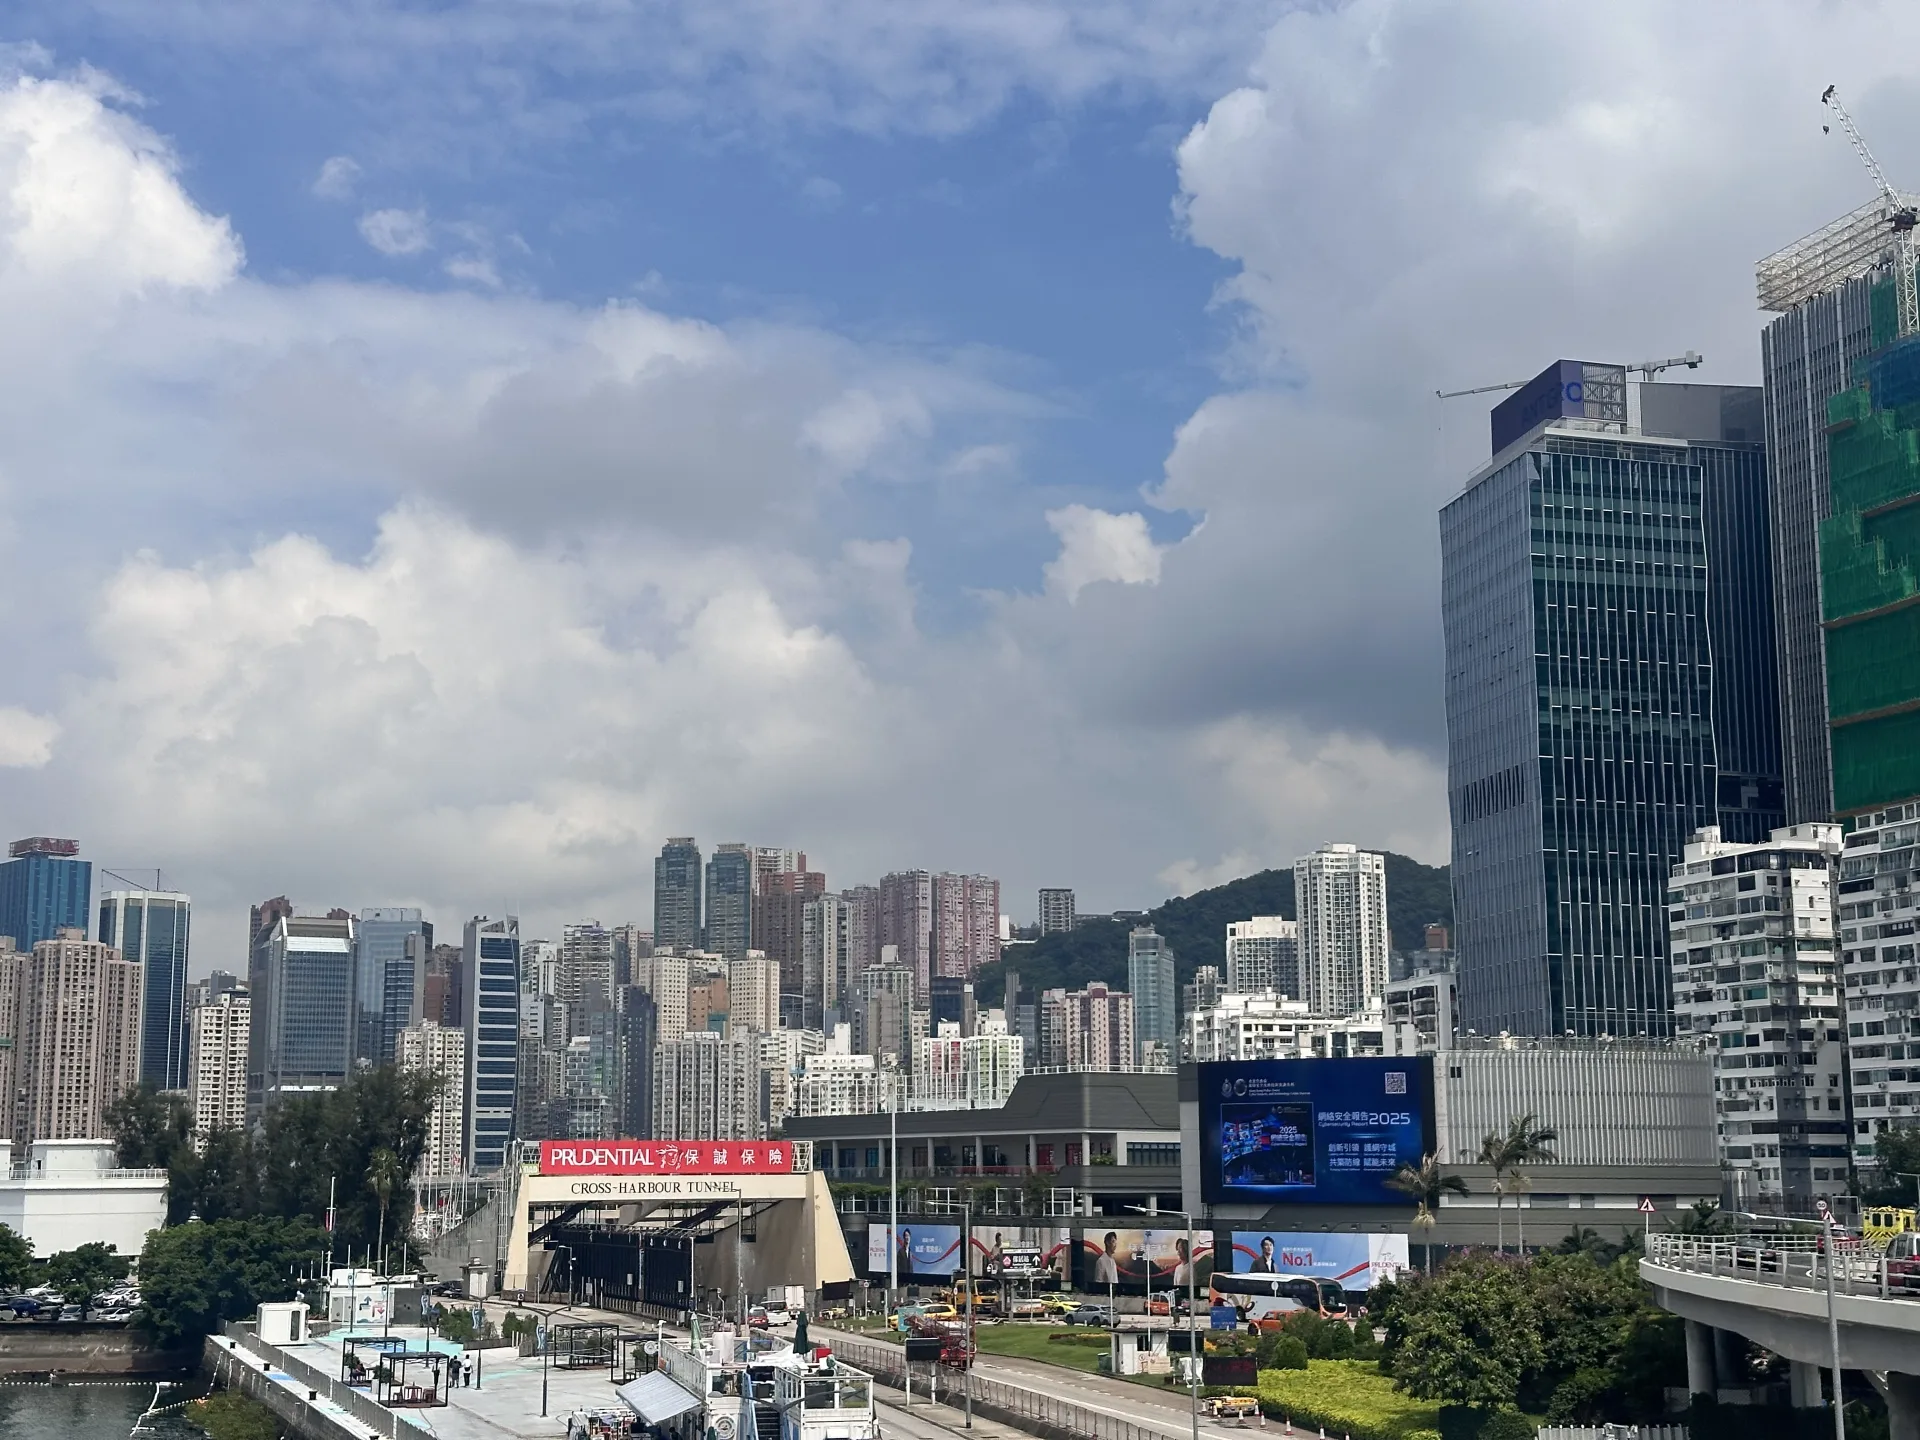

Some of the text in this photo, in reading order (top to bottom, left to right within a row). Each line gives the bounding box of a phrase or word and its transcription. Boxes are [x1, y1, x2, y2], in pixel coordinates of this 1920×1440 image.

[1318, 1112, 1410, 1125] 網絡安全報告 2025
[1280, 1126, 1298, 1134] 2025
[550, 1148, 783, 1166] PRUDENTIAL 保誠保險
[686, 1181, 737, 1193] TUNNEL
[1282, 1252, 1312, 1266] No.1
